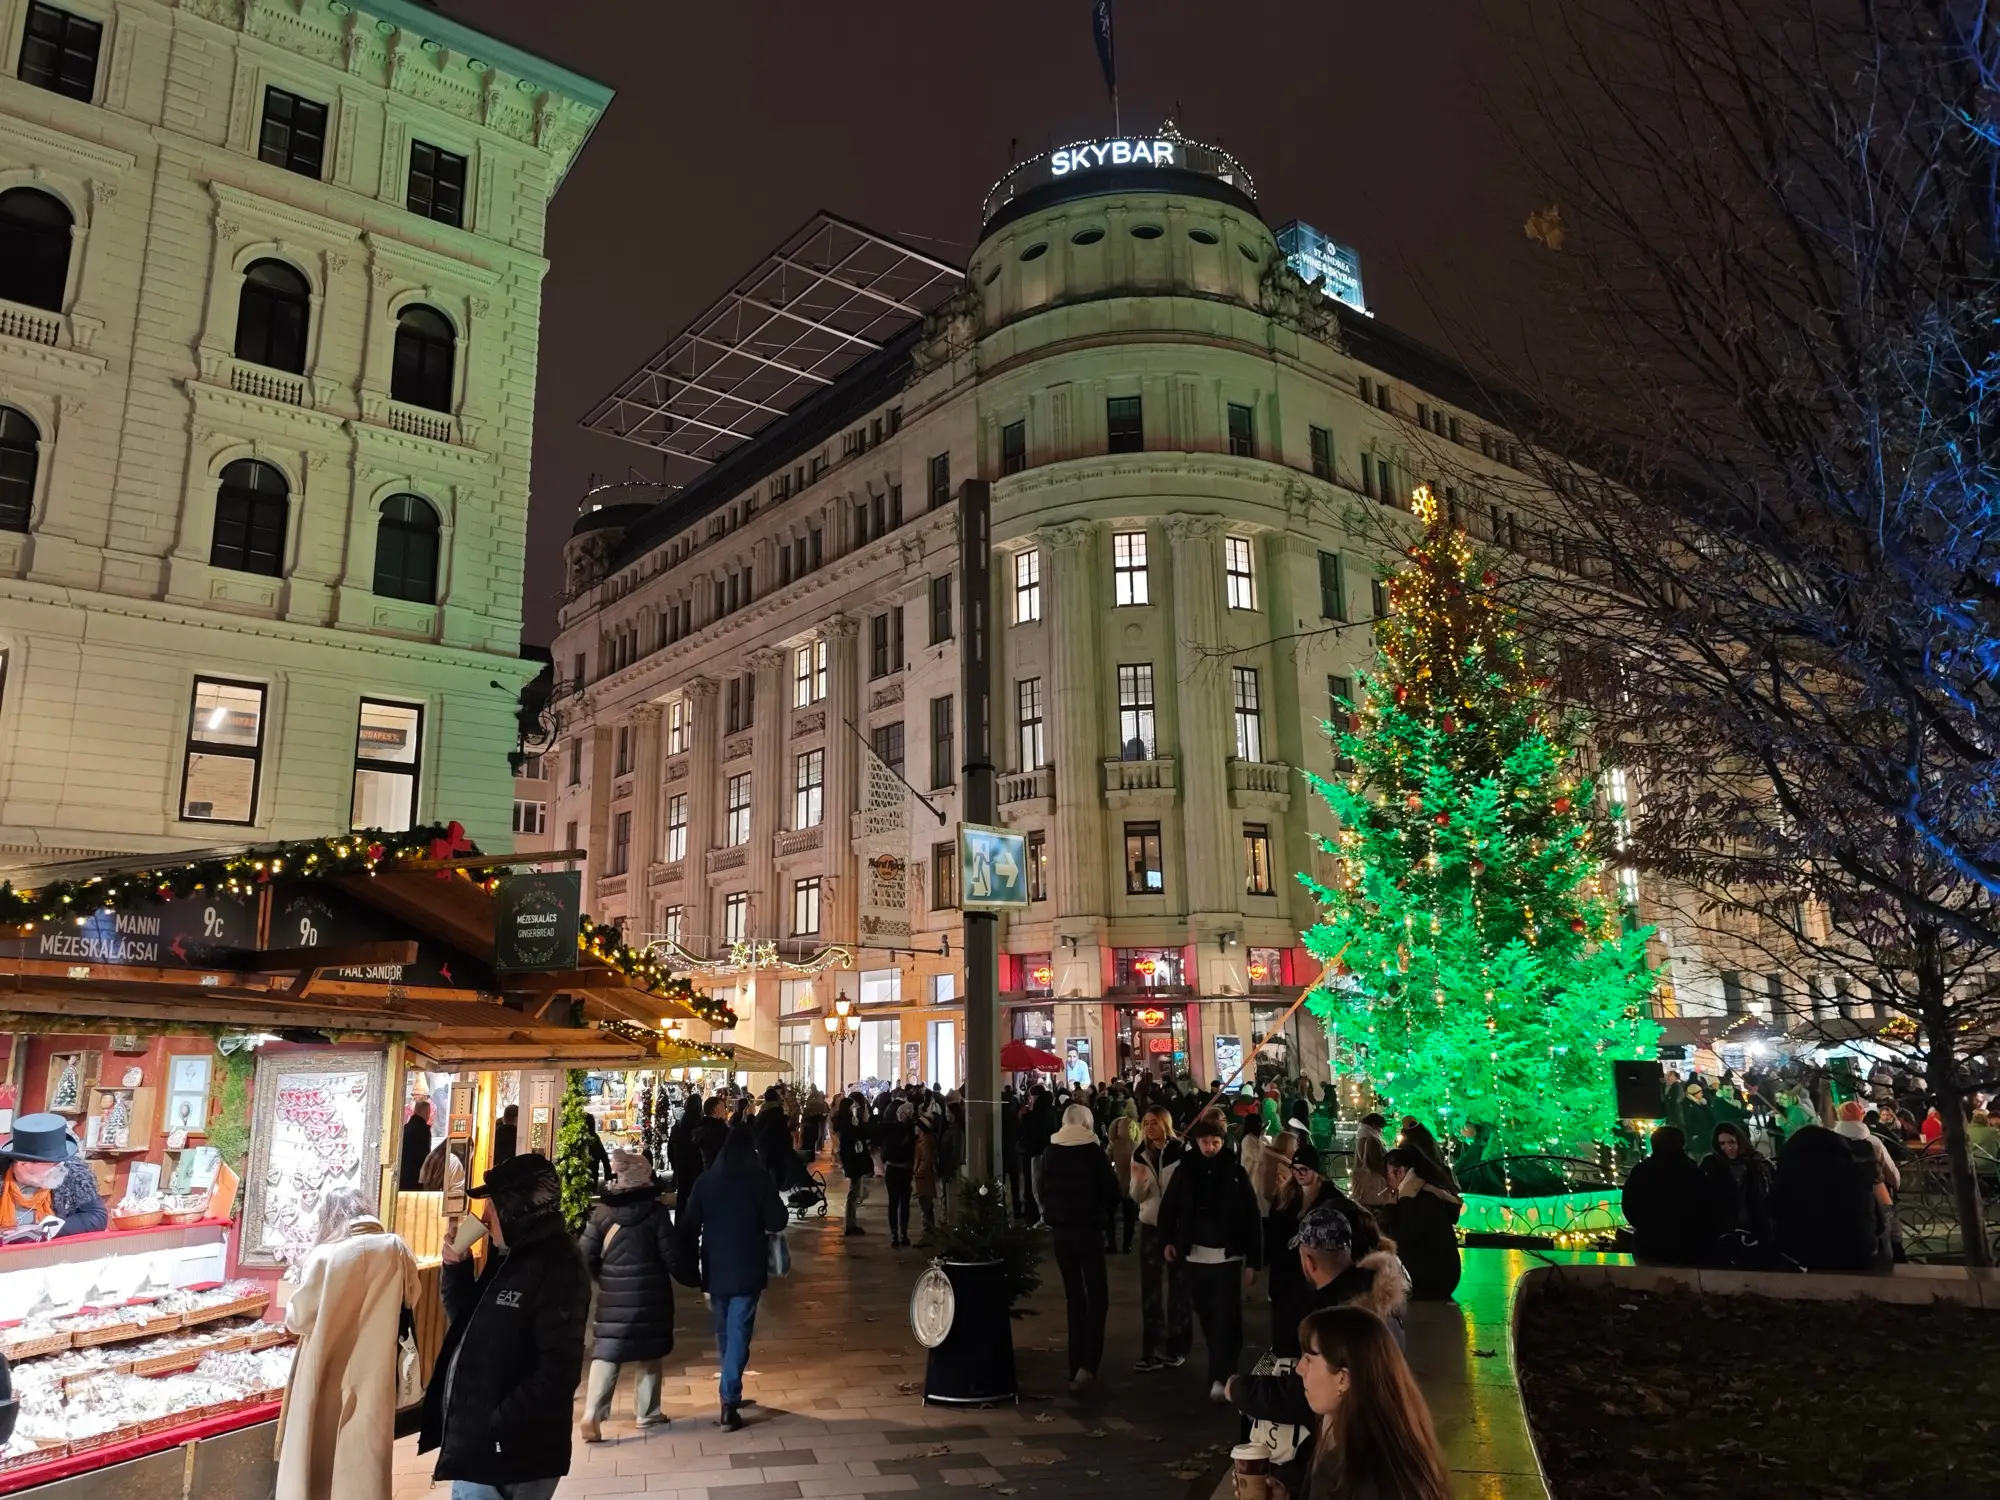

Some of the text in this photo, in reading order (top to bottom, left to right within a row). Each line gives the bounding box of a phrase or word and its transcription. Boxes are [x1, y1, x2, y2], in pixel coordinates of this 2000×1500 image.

[1051, 140, 1174, 175] SKYBAR
[1302, 252, 1322, 272] WINE
[1328, 266, 1358, 289] SKYBAR
[868, 857, 888, 869] Hard
[115, 913, 161, 936] MANNI
[516, 912, 557, 925] MÉZESKALÁCS
[518, 927, 555, 938] GINGERBREAD
[40, 931, 158, 962] MÉZESKALÁCSAI
[497, 1290, 523, 1303] EA7
